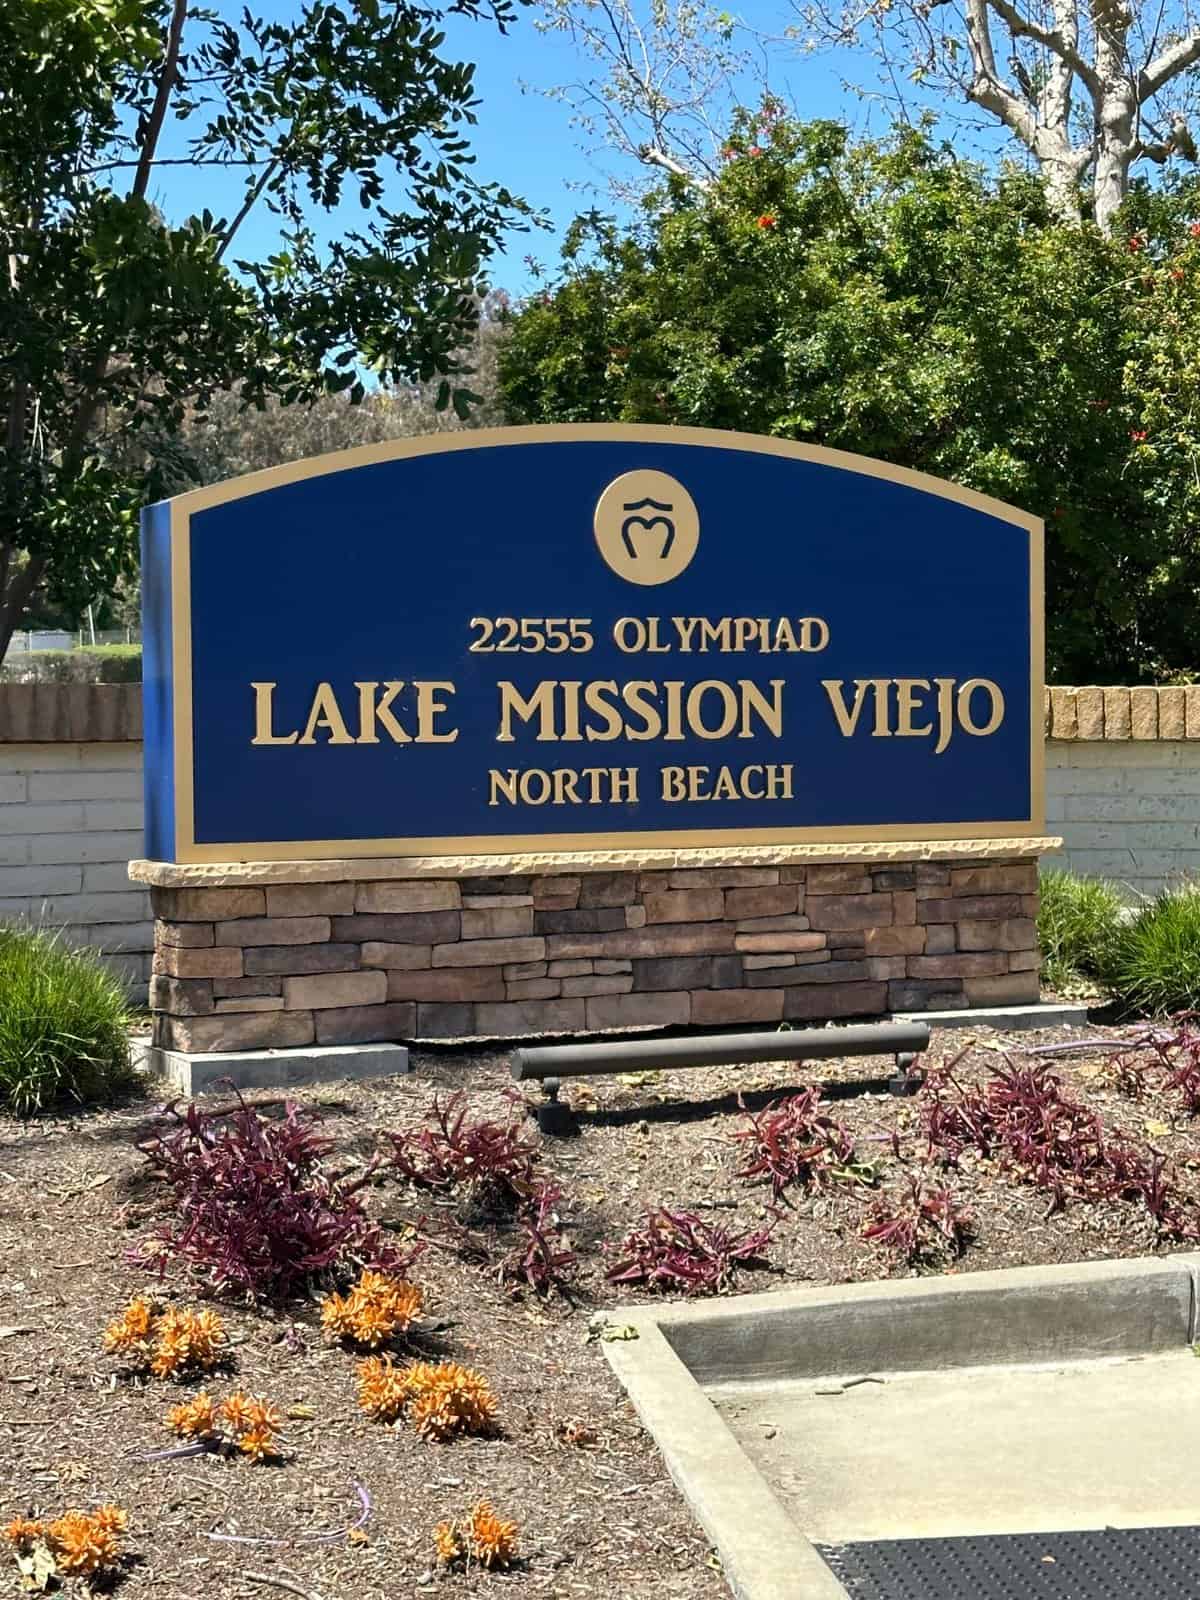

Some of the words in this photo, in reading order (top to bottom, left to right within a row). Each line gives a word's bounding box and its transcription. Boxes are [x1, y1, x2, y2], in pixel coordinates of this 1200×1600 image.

[468, 617, 594, 654] 22555
[613, 616, 830, 654] OLYMPIAD
[250, 679, 459, 746] LAKE
[495, 678, 786, 742] MISSION
[821, 677, 1005, 754] VIEJO
[488, 767, 640, 806] NORTH
[660, 763, 794, 802] BEACH
